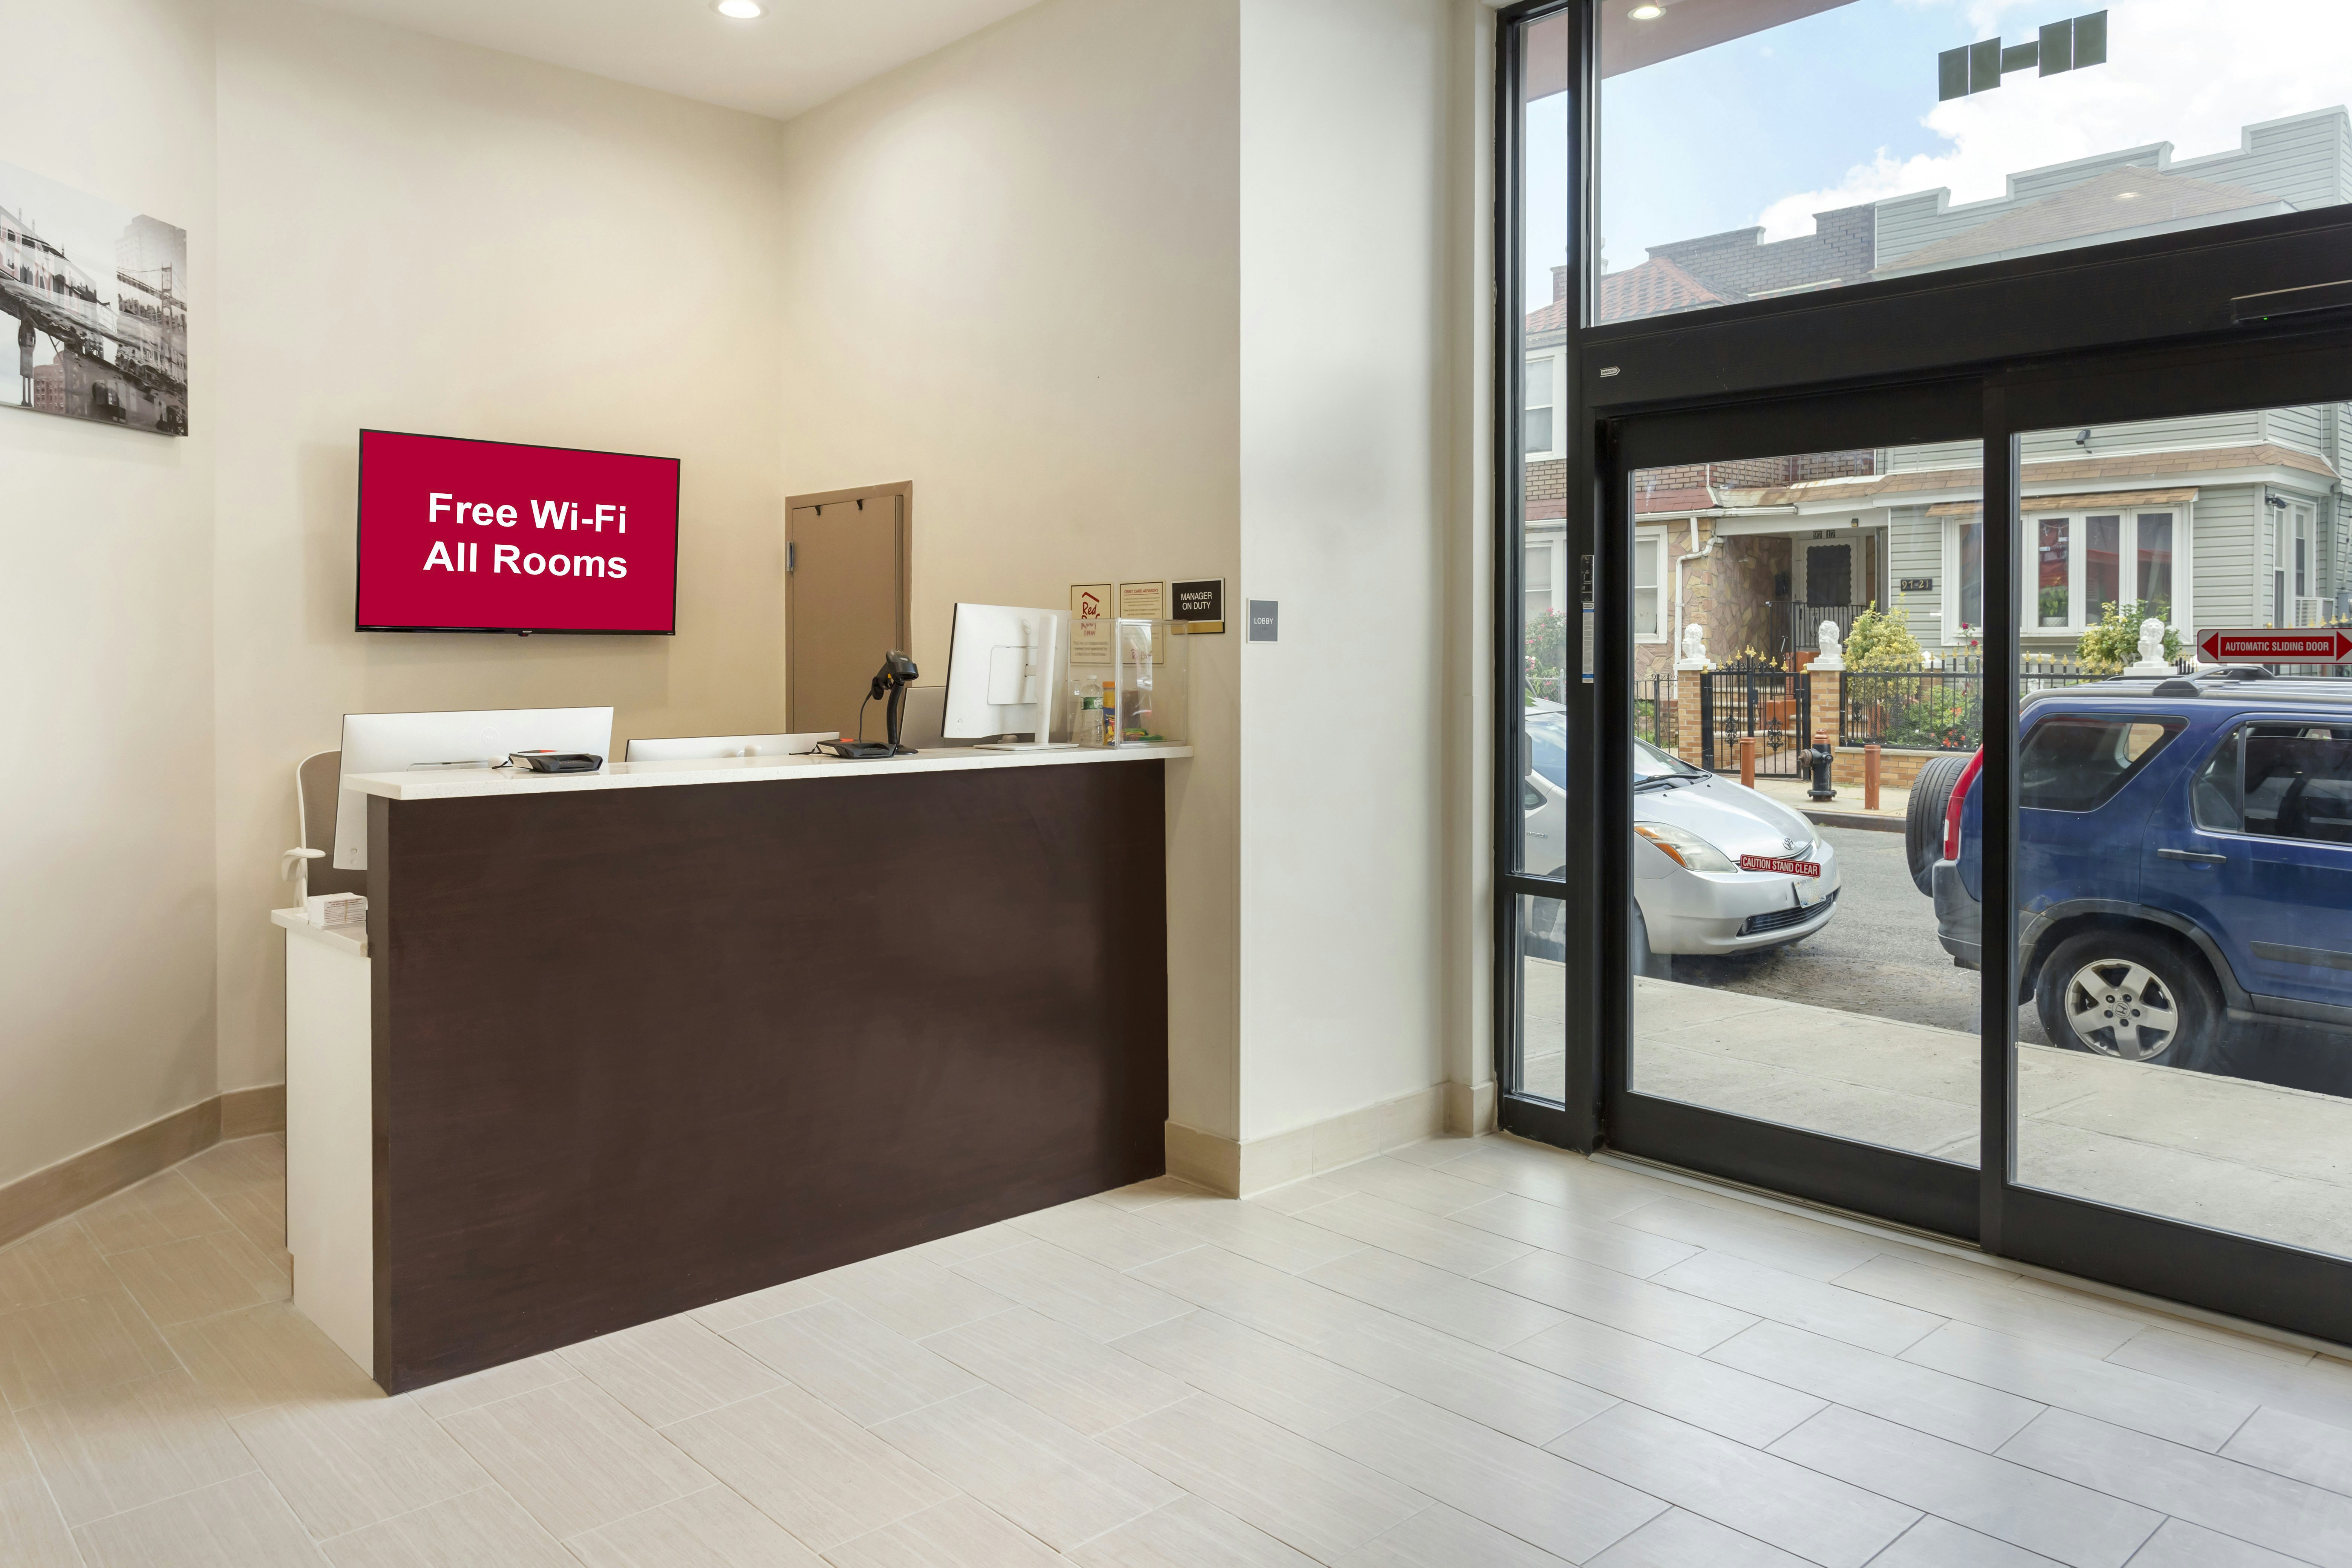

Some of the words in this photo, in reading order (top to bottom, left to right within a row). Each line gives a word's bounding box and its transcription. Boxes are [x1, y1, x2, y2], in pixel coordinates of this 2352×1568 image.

[429, 492, 518, 528] Free
[530, 499, 626, 534] Wi-Fi
[423, 541, 477, 573] All
[493, 544, 627, 579] Rooms
[1181, 592, 1212, 600] MANAGER
[1083, 602, 1096, 616] Red
[1182, 602, 1192, 611] ON
[1193, 601, 1211, 610] DUTY
[2225, 642, 2269, 651] AUTOMATIC
[2272, 642, 2303, 651] SLIDING
[2306, 642, 2329, 651] DOOR
[1743, 857, 1770, 869] CAUTION
[1772, 861, 1793, 872] STAND
[1795, 864, 1818, 875] CLEAR
